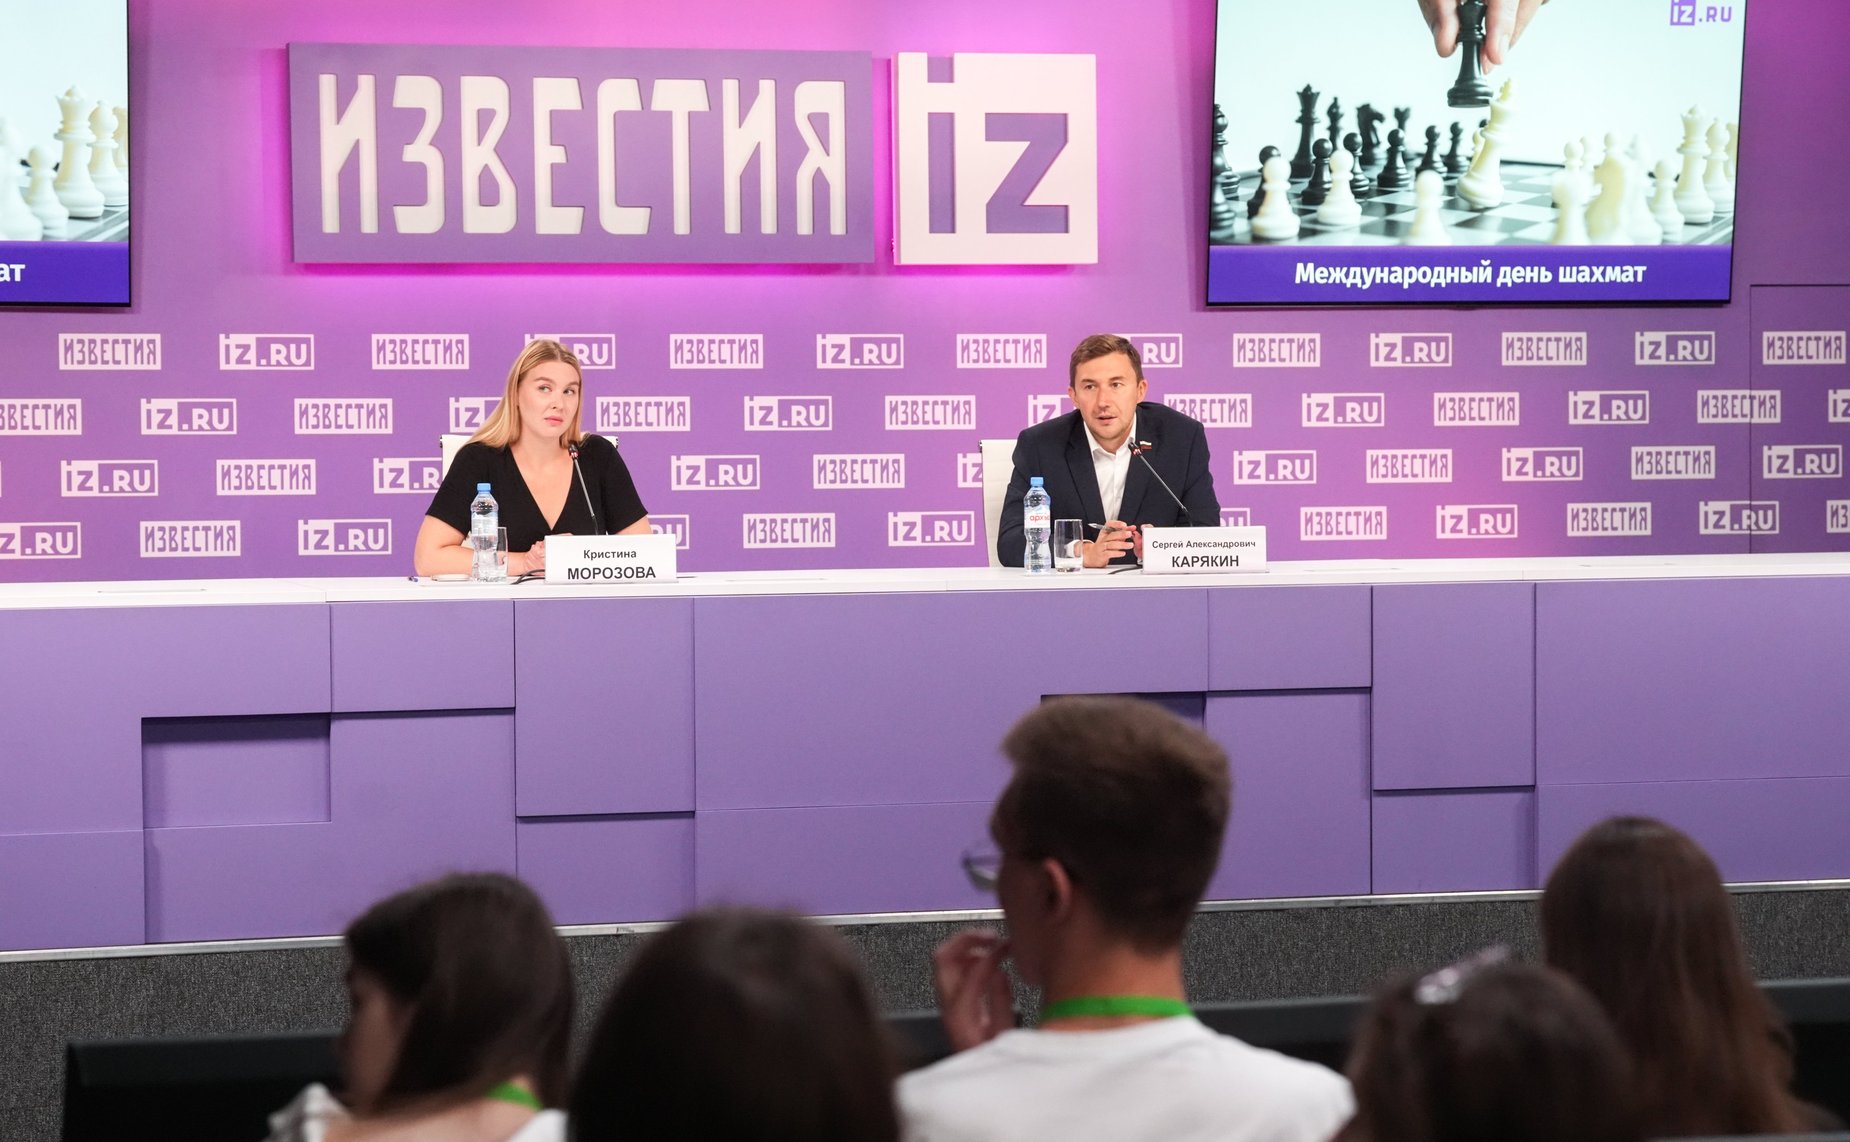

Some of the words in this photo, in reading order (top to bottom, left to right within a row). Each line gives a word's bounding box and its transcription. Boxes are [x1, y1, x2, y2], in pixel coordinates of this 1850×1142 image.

[318, 73, 848, 235] ИЗВЕСТИЯ
[1295, 259, 1492, 289] Международный
[1497, 264, 1552, 288] день
[1558, 264, 1647, 283] шахмат
[63, 338, 157, 365] ИЗВЕСТИЯ
[376, 338, 466, 365] ИЗВЕСТИЯ
[674, 338, 759, 365] ИЗВЕСТИЯ
[961, 337, 1043, 364] ИЗВЕСТИЯ
[1237, 337, 1316, 363] ИЗВЕСТИЯ
[1506, 335, 1583, 361] ИЗВЕСТИЯ
[1766, 335, 1842, 361] ИЗВЕСТИЯ
[0, 404, 77, 430] ЗВЕСТИЯ
[299, 403, 389, 430] ИЗВЕСТИЯ
[601, 401, 686, 428] ИЗВЕСТИЯ
[889, 399, 972, 425] ИЗВЕСТИЯ
[1438, 396, 1516, 422] ИЗВЕСТИЯ
[1701, 394, 1777, 419] ИЗВЕСТИЯ
[379, 458, 440, 489] iz.R
[818, 458, 900, 484] ИЗВЕСТИЯ
[1370, 453, 1449, 479] ИЗВЕСТИЯ
[1635, 450, 1712, 475] ИЗВЕСТИЯ
[221, 464, 312, 490] ИЗВЕСТИЯ
[748, 517, 831, 544] ИЗВЕСТИЯ
[1305, 511, 1382, 536] ИЗВЕСТИЯ
[1571, 506, 1648, 532] ИЗВЕСТИЯ
[0, 532, 74, 554] z.RU
[145, 525, 236, 552] ИЗВЕСТИЯ
[1152, 540, 1182, 549] Сергей
[1186, 540, 1256, 549] Александрович
[583, 549, 637, 560] Кристина
[1172, 555, 1239, 567] КАРЯКИН
[567, 566, 656, 579] МОРОЗОВА
